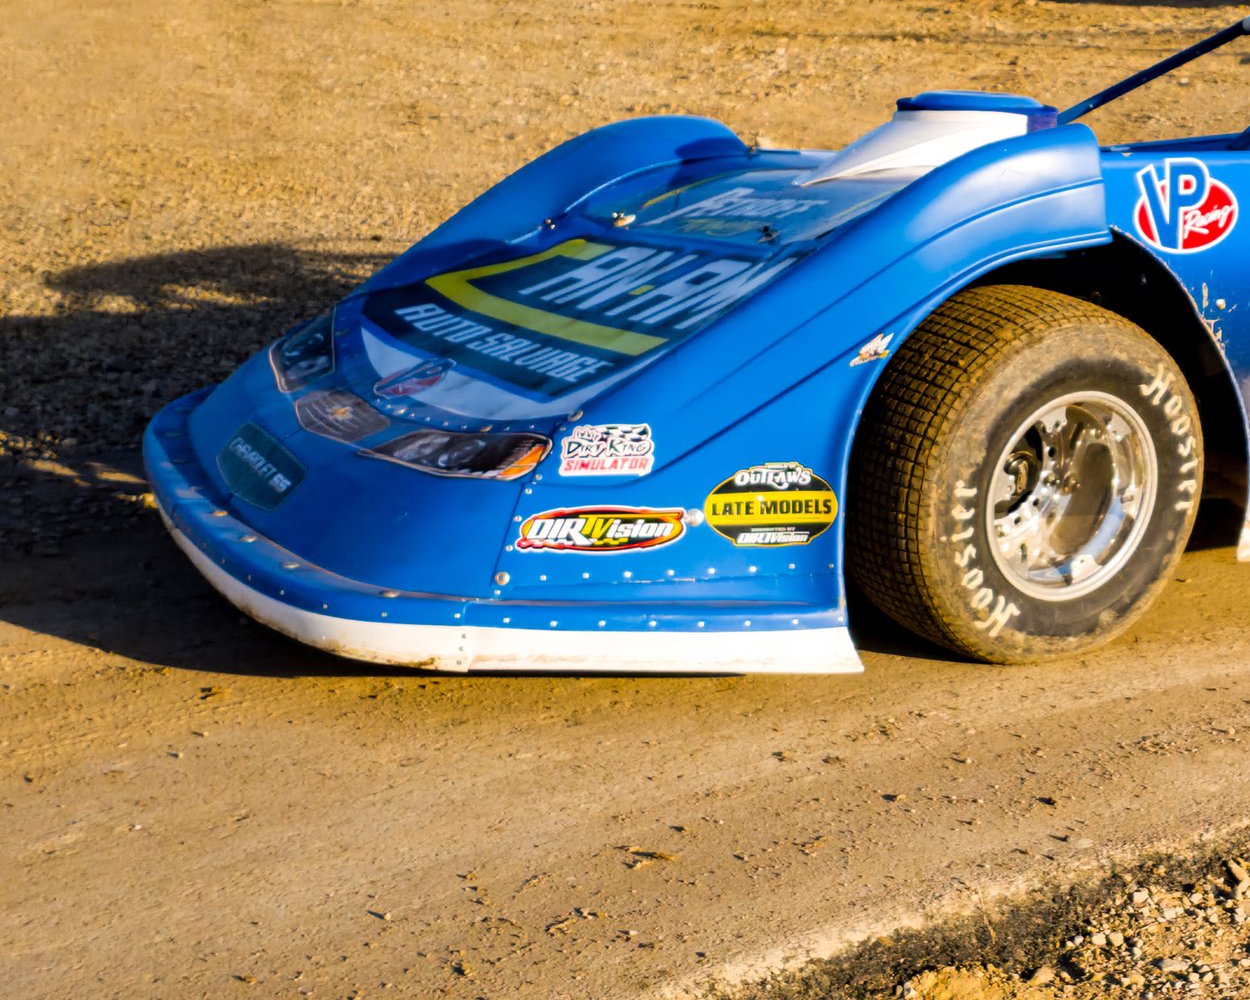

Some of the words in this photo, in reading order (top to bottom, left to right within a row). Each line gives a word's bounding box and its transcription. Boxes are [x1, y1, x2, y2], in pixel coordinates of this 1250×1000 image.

[1136, 157, 1210, 251] VP
[1183, 204, 1236, 239] Racing
[564, 458, 649, 472] SIMULATOR
[712, 501, 755, 516] LATE
[760, 499, 832, 515] MODELS
